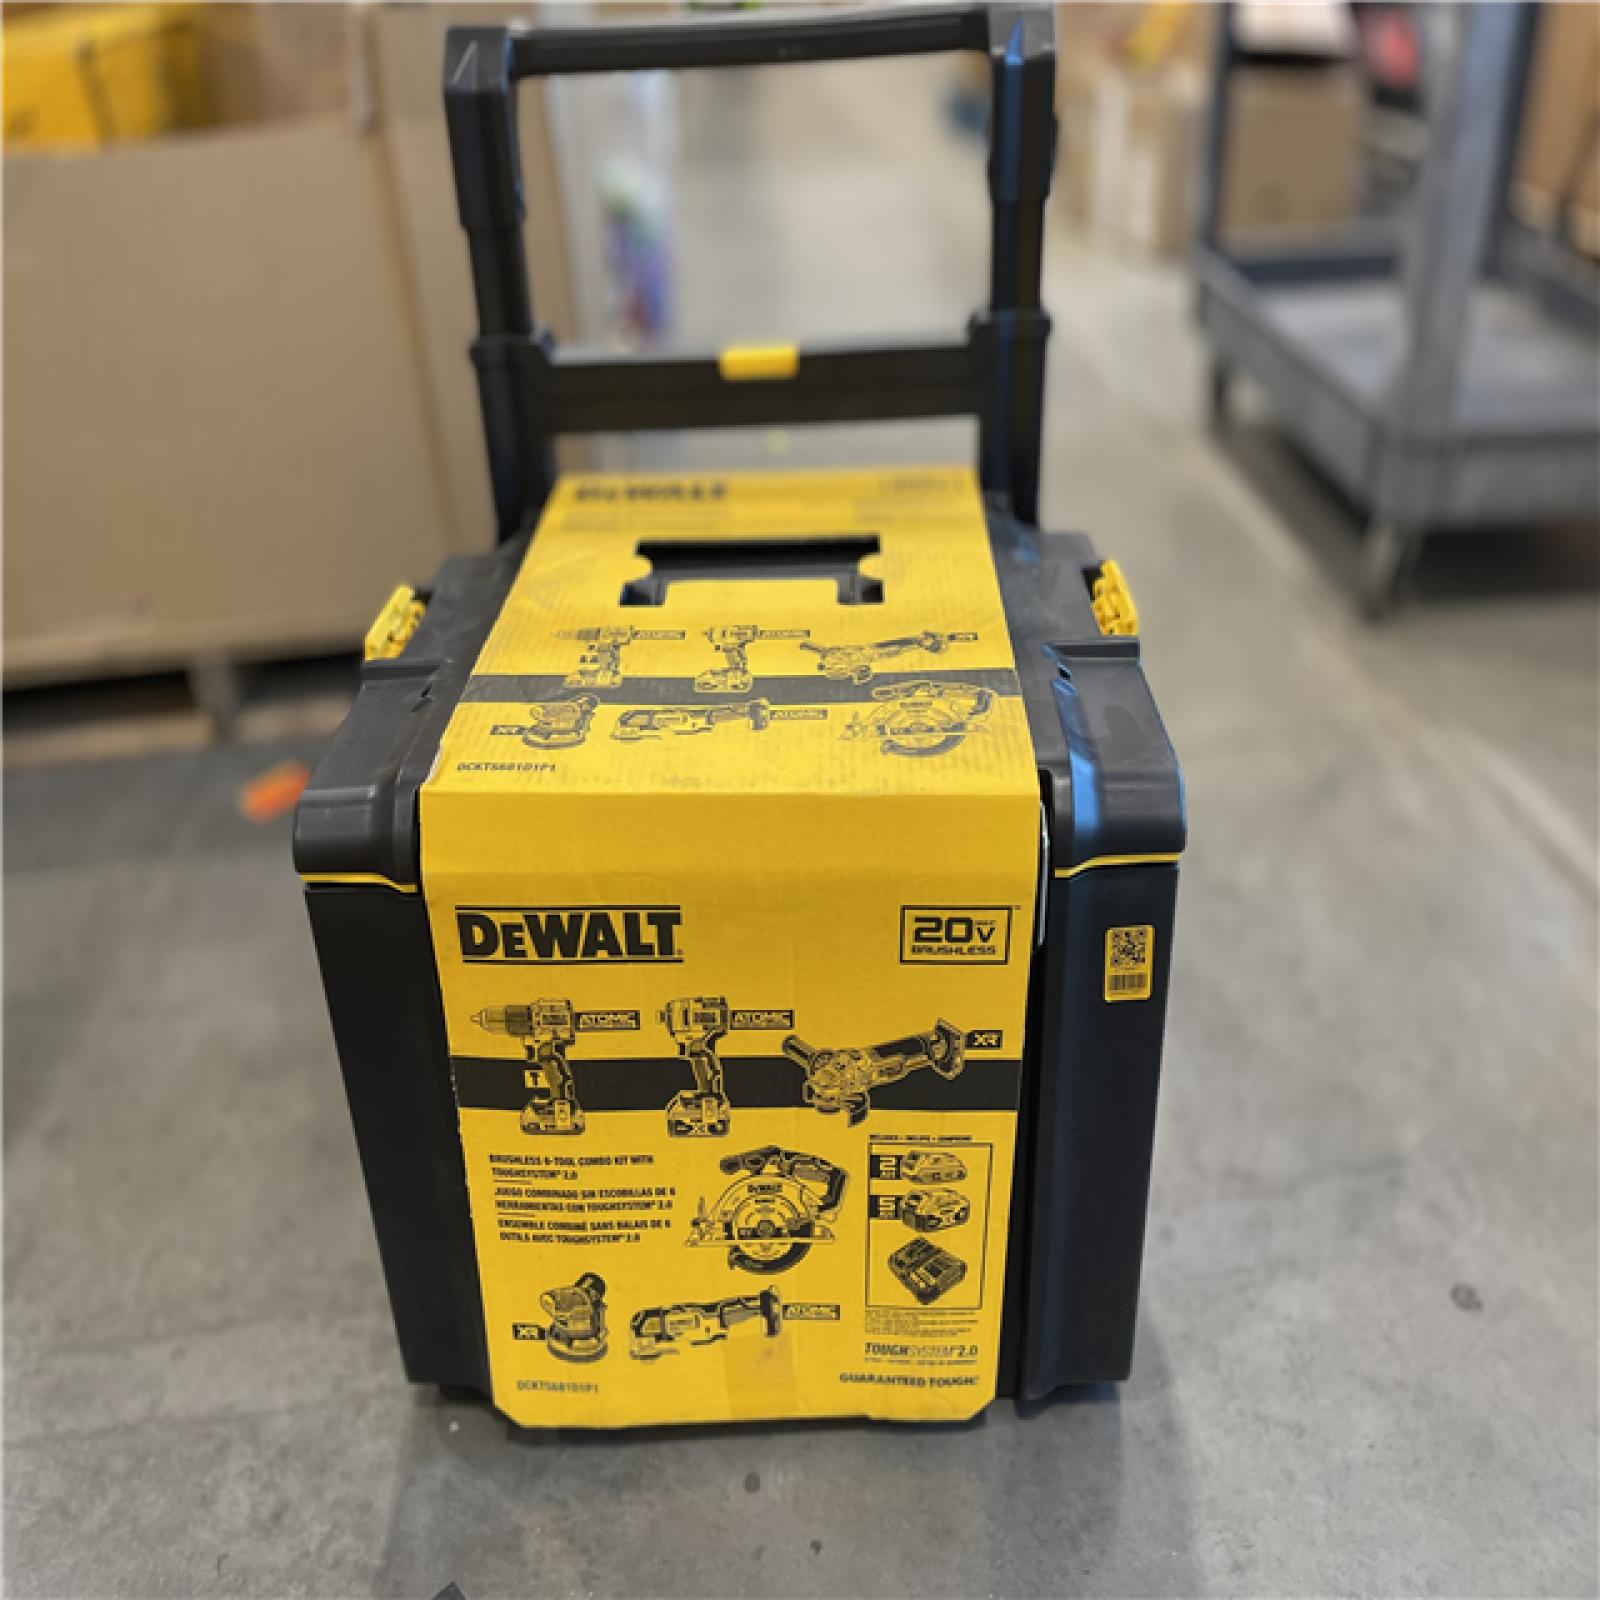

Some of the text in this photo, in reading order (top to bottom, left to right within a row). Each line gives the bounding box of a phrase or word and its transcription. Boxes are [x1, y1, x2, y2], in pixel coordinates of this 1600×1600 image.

[457, 911, 683, 958] DEWALT
[911, 945, 996, 955] BRUSHLESS
[579, 1012, 636, 1029] ATOMIC
[733, 1011, 792, 1028] ATOMIC
